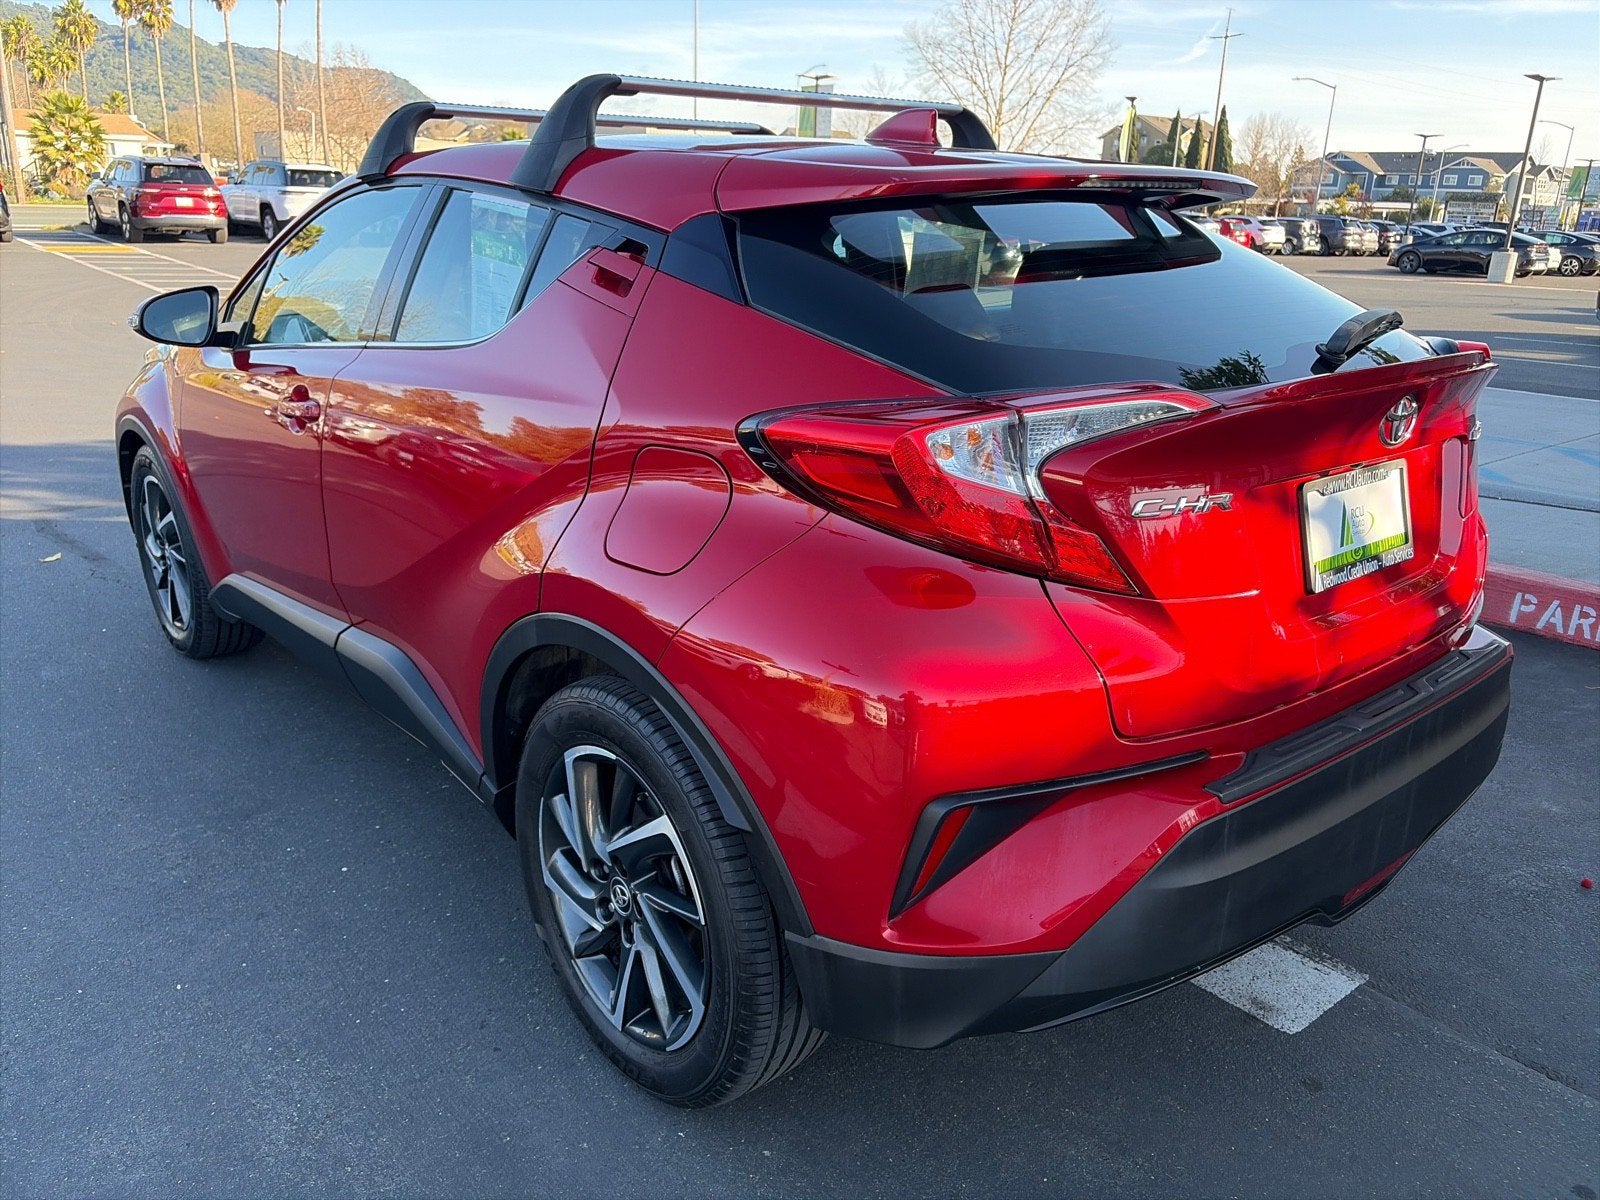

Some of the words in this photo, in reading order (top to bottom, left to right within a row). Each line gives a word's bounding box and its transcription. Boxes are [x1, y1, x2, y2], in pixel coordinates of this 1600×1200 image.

[1131, 492, 1233, 517] C-HR
[1351, 505, 1365, 519] RCU
[1323, 567, 1347, 588] Redwood
[1347, 562, 1363, 580] Credit
[1362, 558, 1378, 575] Union
[1382, 553, 1394, 567] Auto
[1393, 547, 1414, 563] Services
